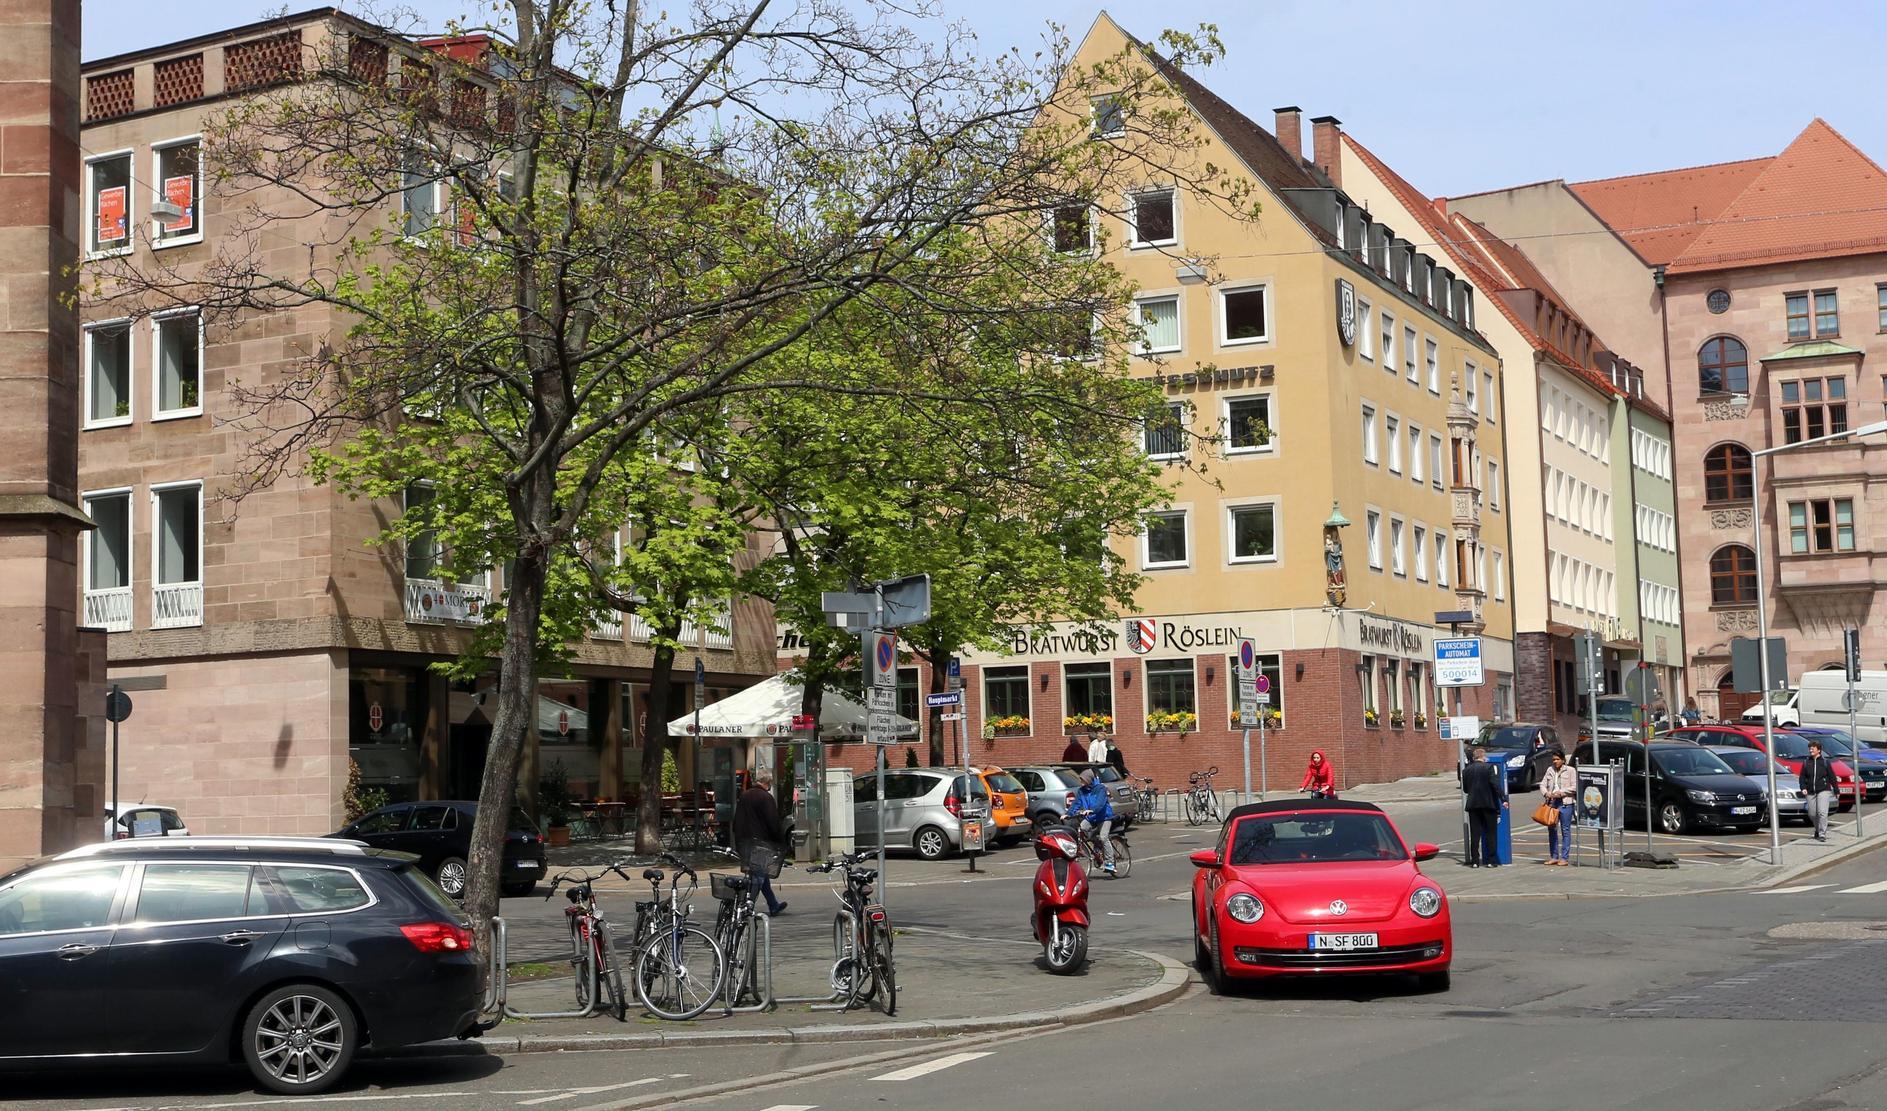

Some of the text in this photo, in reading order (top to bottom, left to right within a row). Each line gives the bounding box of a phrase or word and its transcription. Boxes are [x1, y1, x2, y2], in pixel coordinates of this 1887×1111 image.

[1163, 622, 1241, 652] RÖSLEIN
[1438, 641, 1477, 650] PARKSCHEIN-
[1445, 650, 1472, 658] AUTOMAT
[1442, 670, 1477, 679] 500014
[928, 695, 958, 704] Hauptmarkt
[699, 725, 743, 733] PAULANER
[1320, 935, 1374, 947] N SF 800
